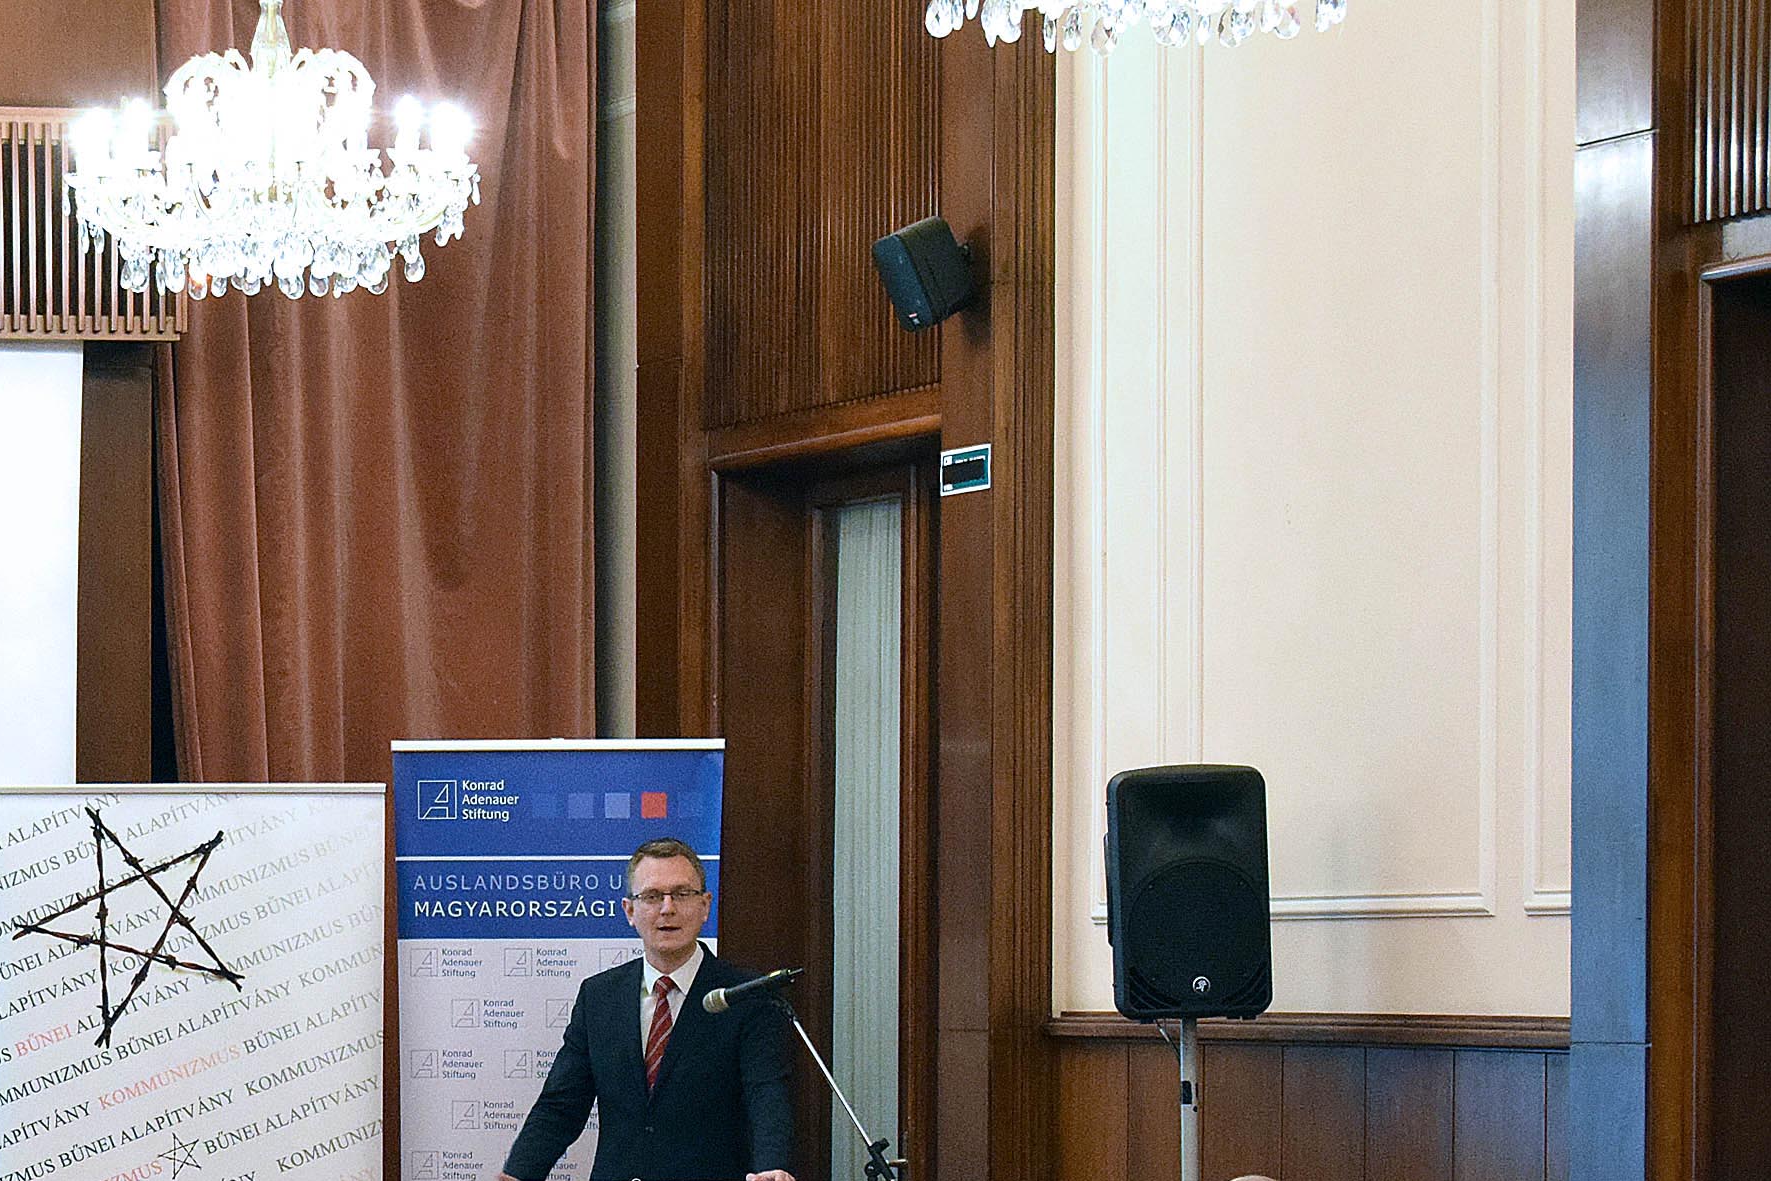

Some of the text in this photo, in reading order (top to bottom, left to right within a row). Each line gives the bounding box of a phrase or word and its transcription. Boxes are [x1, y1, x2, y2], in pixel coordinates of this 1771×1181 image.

[461, 779, 505, 792] Konrad
[461, 794, 519, 806] Adenauer
[461, 807, 510, 822] Stiftung
[180, 848, 311, 909] OMMUNIZMUS
[414, 873, 599, 891] AUSLANDSBÜRO
[254, 886, 311, 921] BŰNEI
[414, 895, 617, 918] MAGYARORSZÁGI
[442, 948, 472, 957] Konrad
[536, 948, 567, 957] Konrad
[442, 958, 483, 967] Adenauer
[536, 958, 578, 967] Adenauer
[442, 968, 476, 979] Stiftung
[536, 968, 570, 979] Stiftung
[483, 999, 514, 1008] Konrad
[483, 1009, 524, 1018] Adenauer
[115, 1026, 173, 1060] BŰNEI
[176, 979, 292, 1038] ALAPÍTVÁNY
[483, 1019, 518, 1030] Stiftung
[14, 1023, 72, 1057] BŰNEI
[442, 1049, 473, 1058] Konrad
[97, 1044, 241, 1111] KOMMUNIZMUS
[243, 1020, 302, 1054] BŰNEI
[442, 1060, 484, 1069] Adenauer
[442, 1070, 476, 1080] Stiftung
[484, 1100, 514, 1109] Konrad
[202, 1121, 262, 1156] BŰNEI
[264, 1074, 380, 1134] ALAPÍTVÁNY
[484, 1111, 525, 1120] Adenauer
[58, 1133, 117, 1168] BŰNEI
[120, 1088, 235, 1146] ALAPÍTVÁNY
[484, 1121, 518, 1131] Stiftung
[442, 1151, 474, 1160] Konrad
[442, 1162, 484, 1171] Adenauer
[442, 1172, 477, 1181] Stiftung
